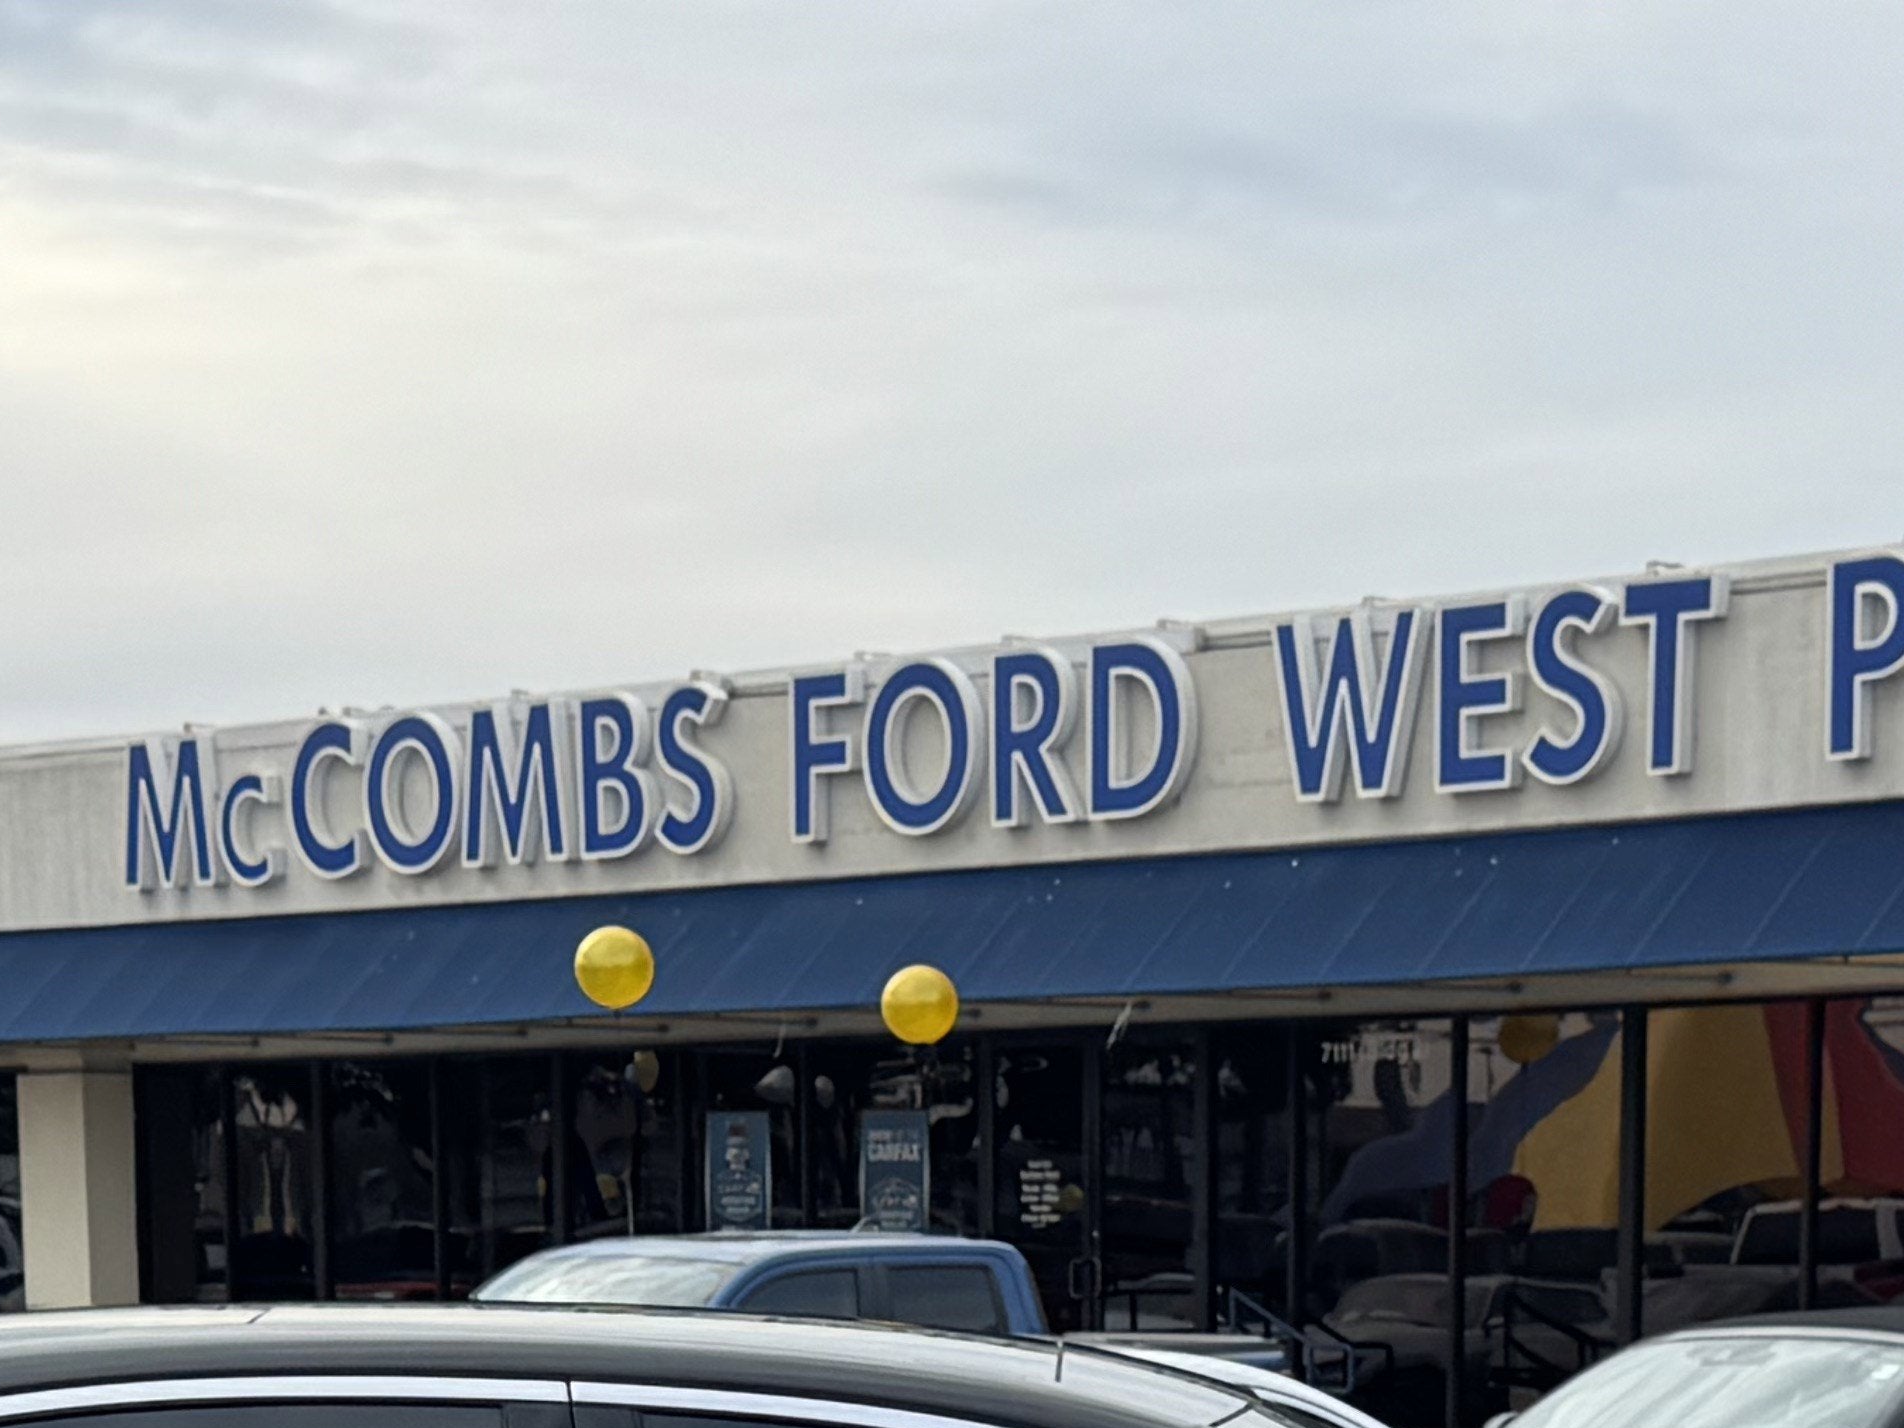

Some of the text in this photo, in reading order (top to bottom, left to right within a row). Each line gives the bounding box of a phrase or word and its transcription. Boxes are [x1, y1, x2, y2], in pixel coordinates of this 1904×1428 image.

[124, 683, 726, 888] McCOMBS
[788, 636, 1194, 843] FORD
[1271, 577, 1718, 802] WEST
